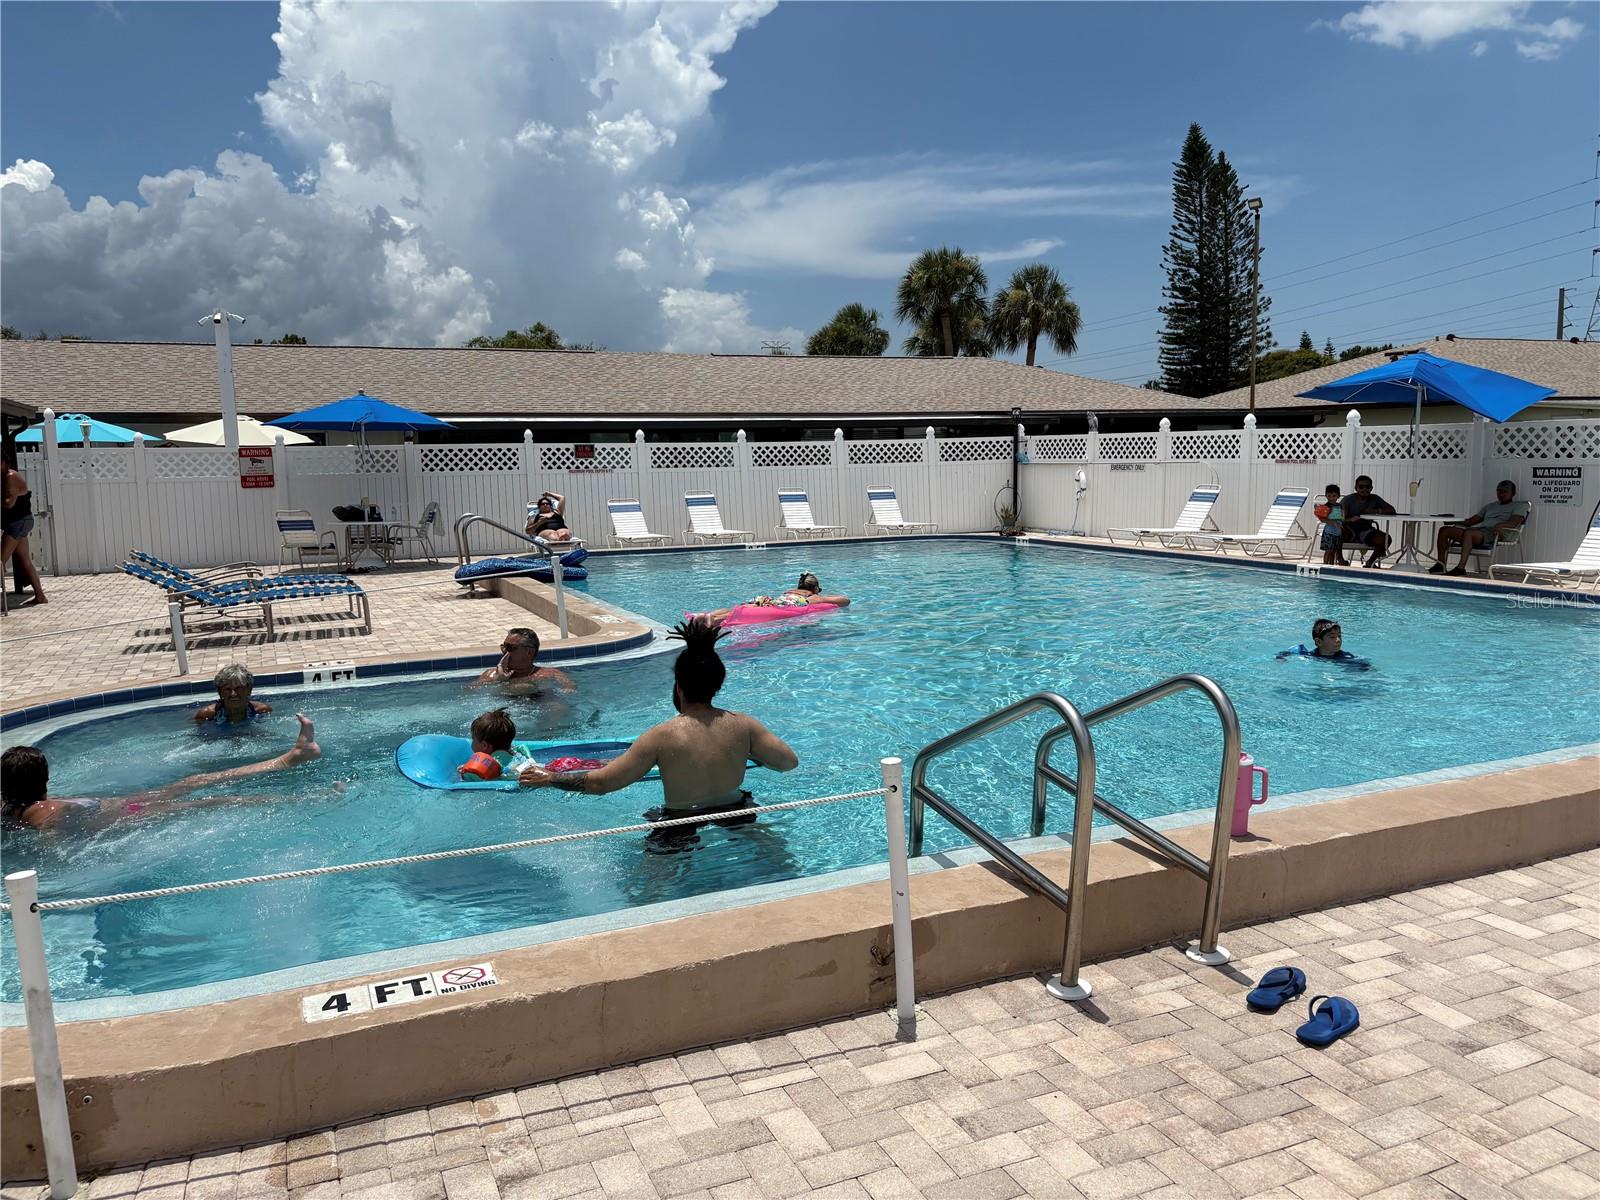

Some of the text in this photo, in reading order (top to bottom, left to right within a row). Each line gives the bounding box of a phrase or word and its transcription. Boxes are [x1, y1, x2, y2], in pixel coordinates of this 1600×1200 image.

[1536, 469, 1578, 477] WARNING
[332, 670, 353, 682] FT
[460, 979, 497, 991] DIVING
[321, 976, 433, 1013] 4 FT.
